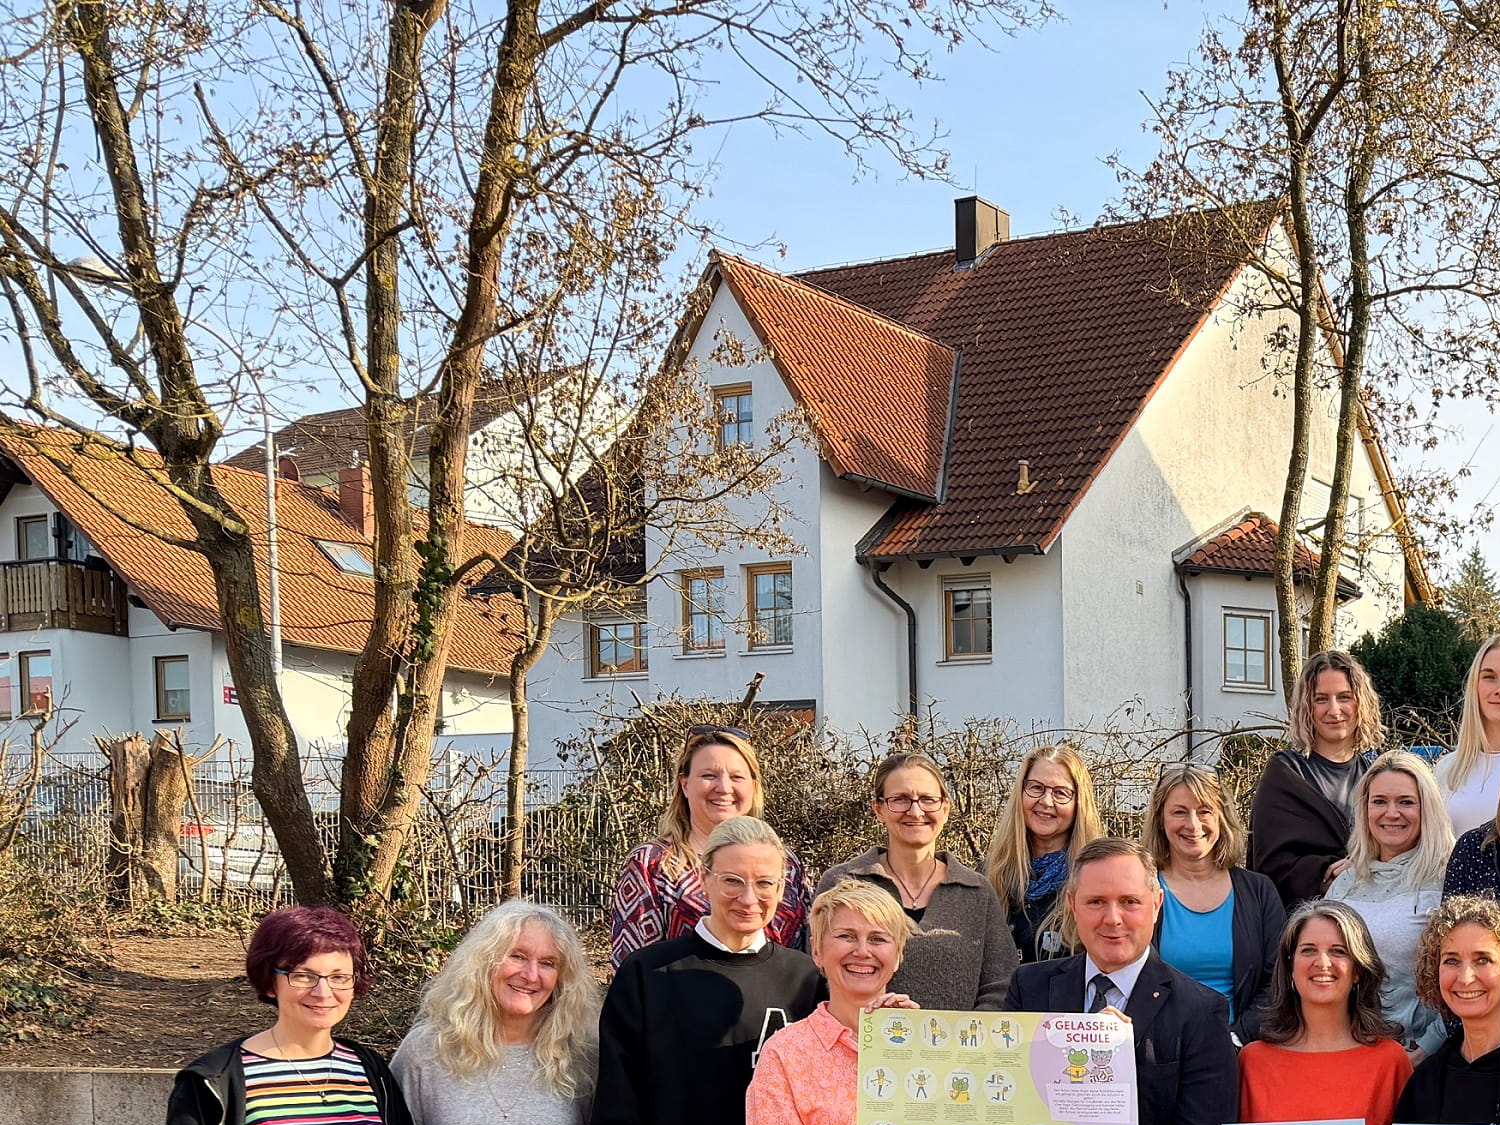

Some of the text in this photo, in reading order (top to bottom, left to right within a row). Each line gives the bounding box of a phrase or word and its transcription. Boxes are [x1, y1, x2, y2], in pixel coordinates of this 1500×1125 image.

[1055, 1020, 1119, 1032] GELASSENE
[863, 1016, 873, 1051] YOGA
[1066, 1033, 1110, 1043] SCHULE
